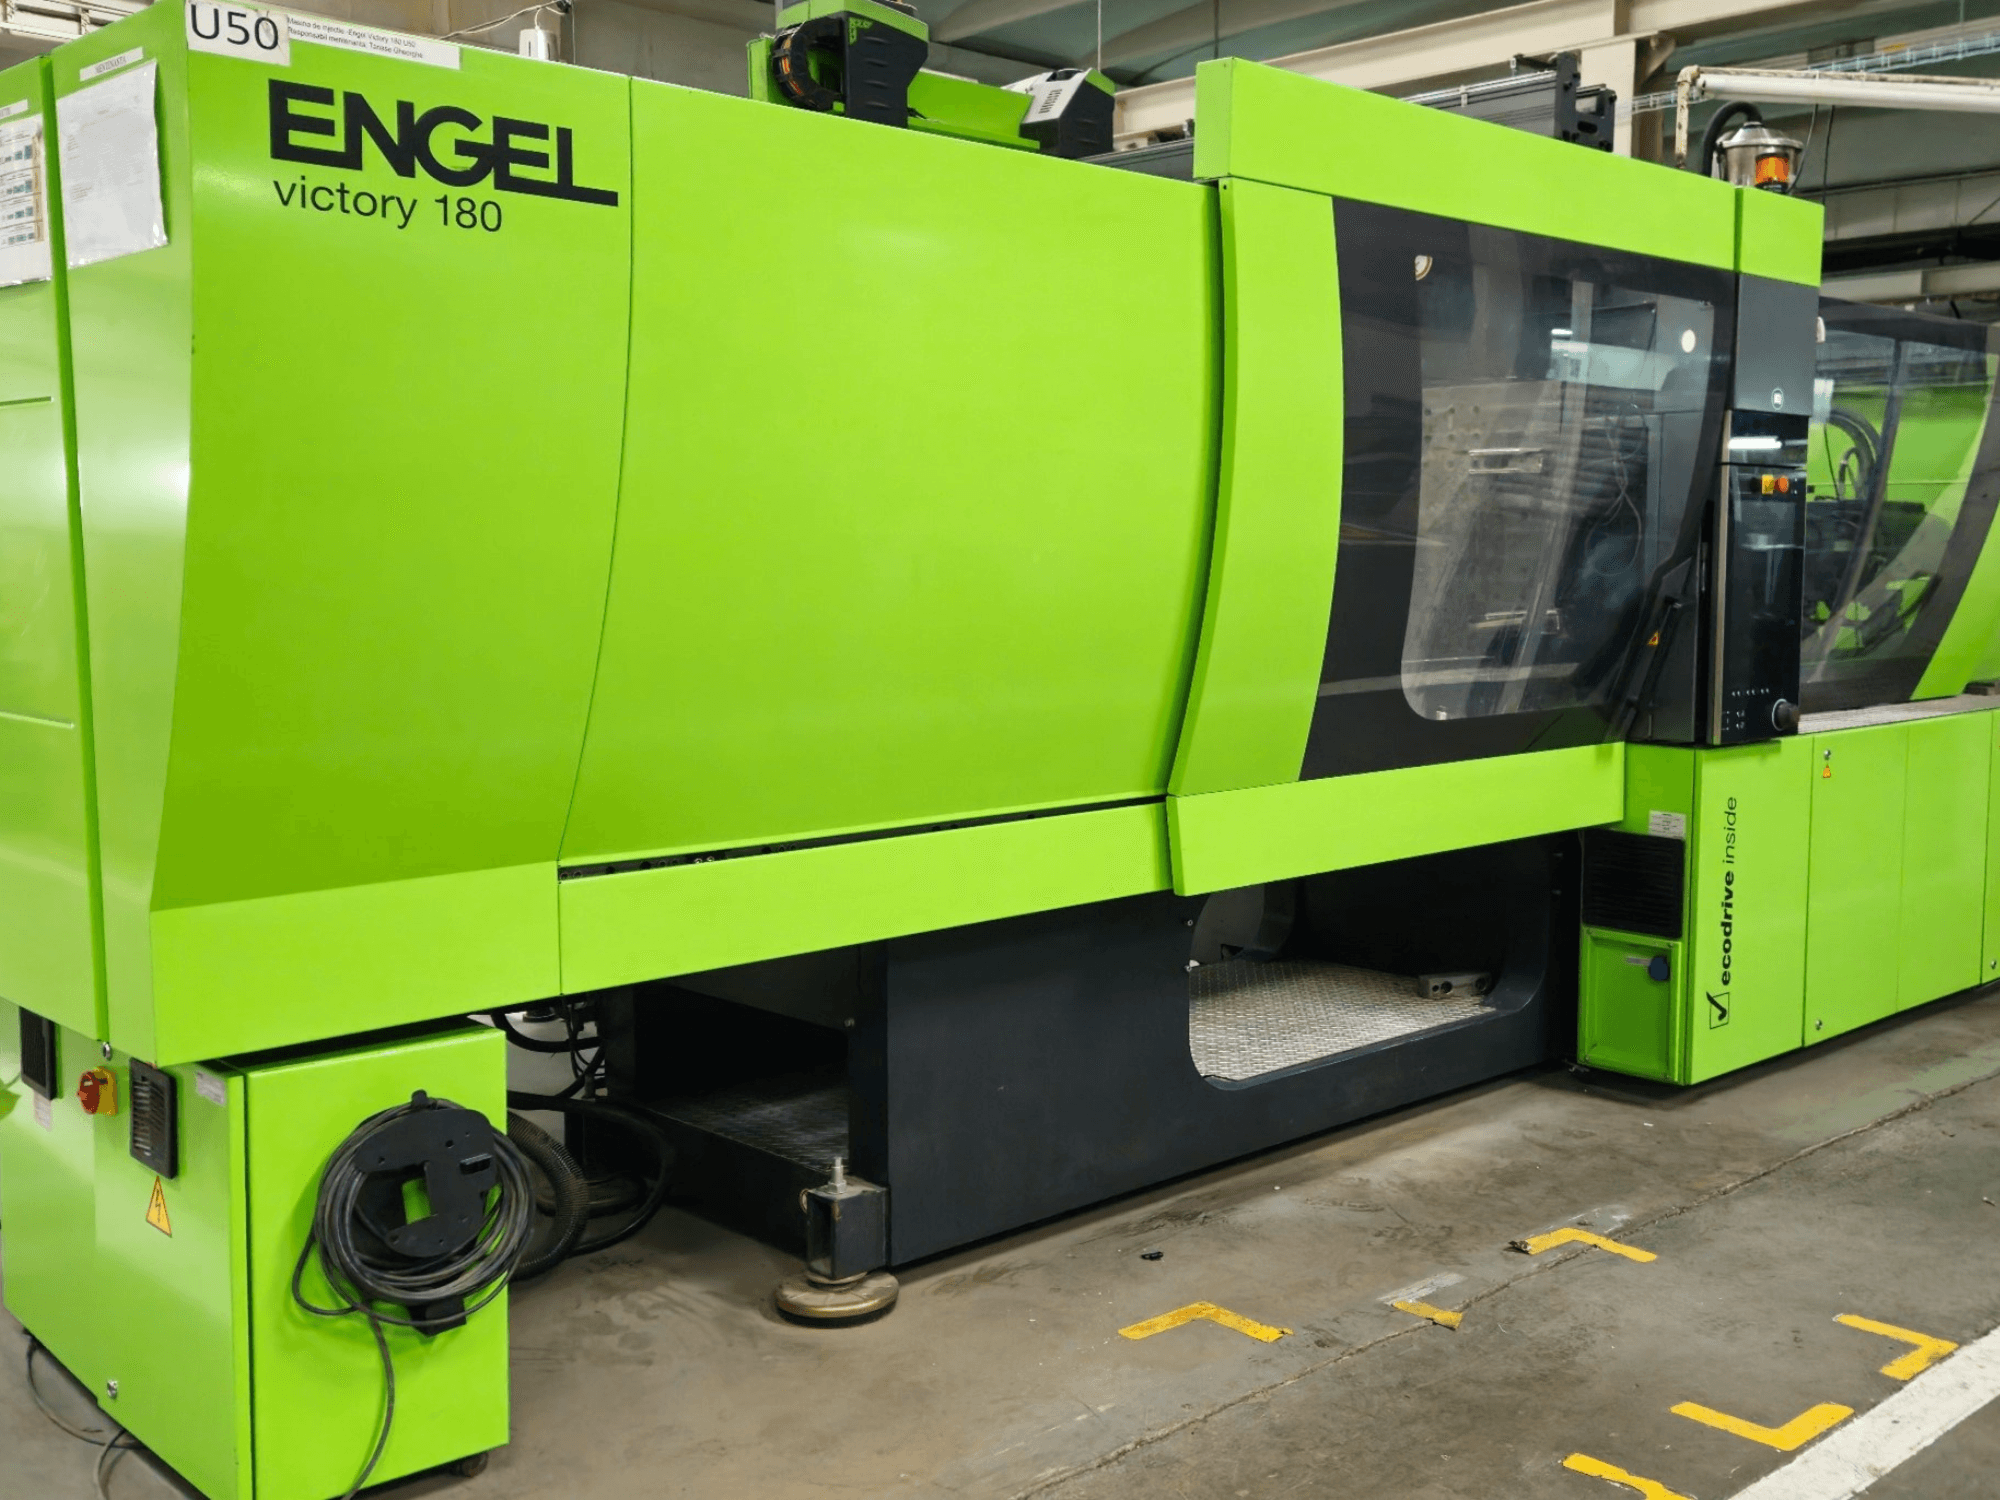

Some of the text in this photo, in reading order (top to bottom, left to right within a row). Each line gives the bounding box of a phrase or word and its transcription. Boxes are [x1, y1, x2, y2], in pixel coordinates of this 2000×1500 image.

[190, 3, 279, 50] U50
[268, 78, 619, 207] ENGEL
[273, 175, 503, 232] victory 180
[1720, 796, 1737, 986] ecodrive inside
